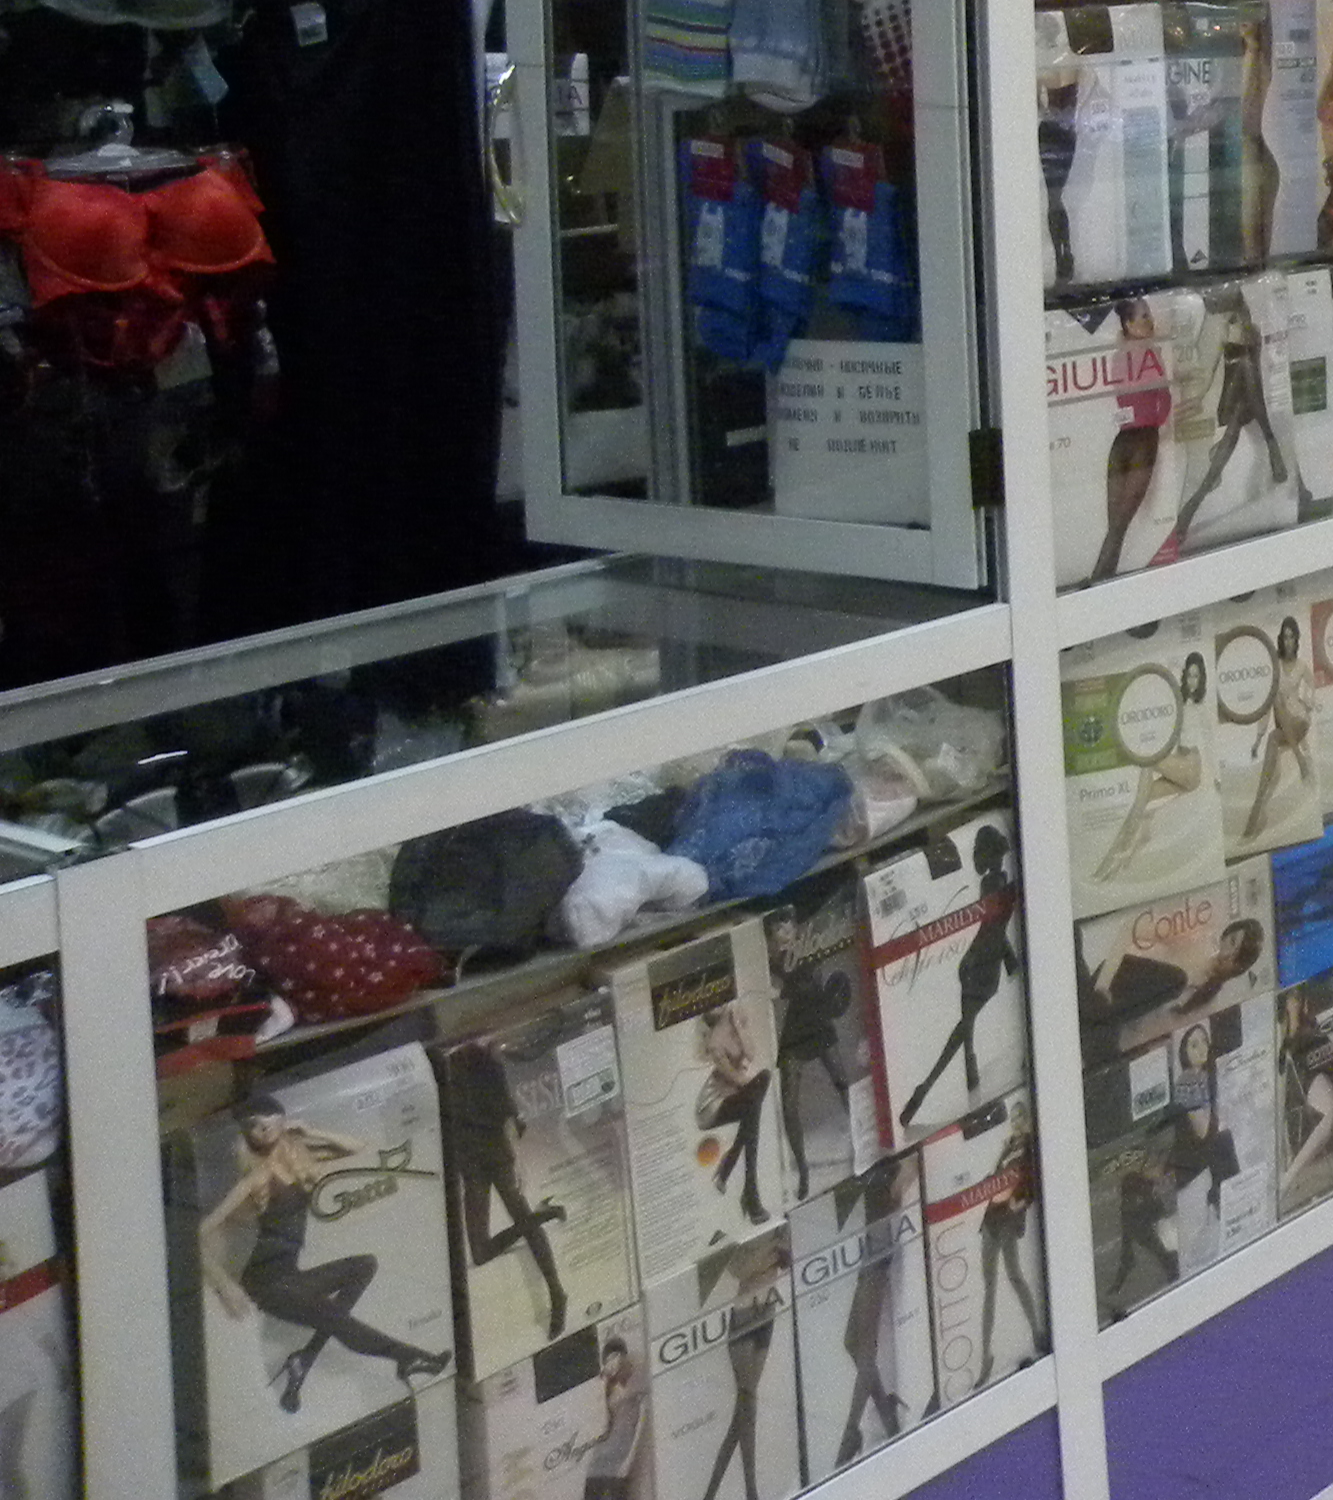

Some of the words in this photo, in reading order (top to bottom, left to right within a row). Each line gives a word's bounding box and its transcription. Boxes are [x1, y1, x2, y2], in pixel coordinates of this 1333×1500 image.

[918, 904, 987, 946] MARILYN
[1131, 898, 1213, 951] Conte
[801, 1212, 917, 1287] GIULIA
[658, 1285, 786, 1366] GIULIA
